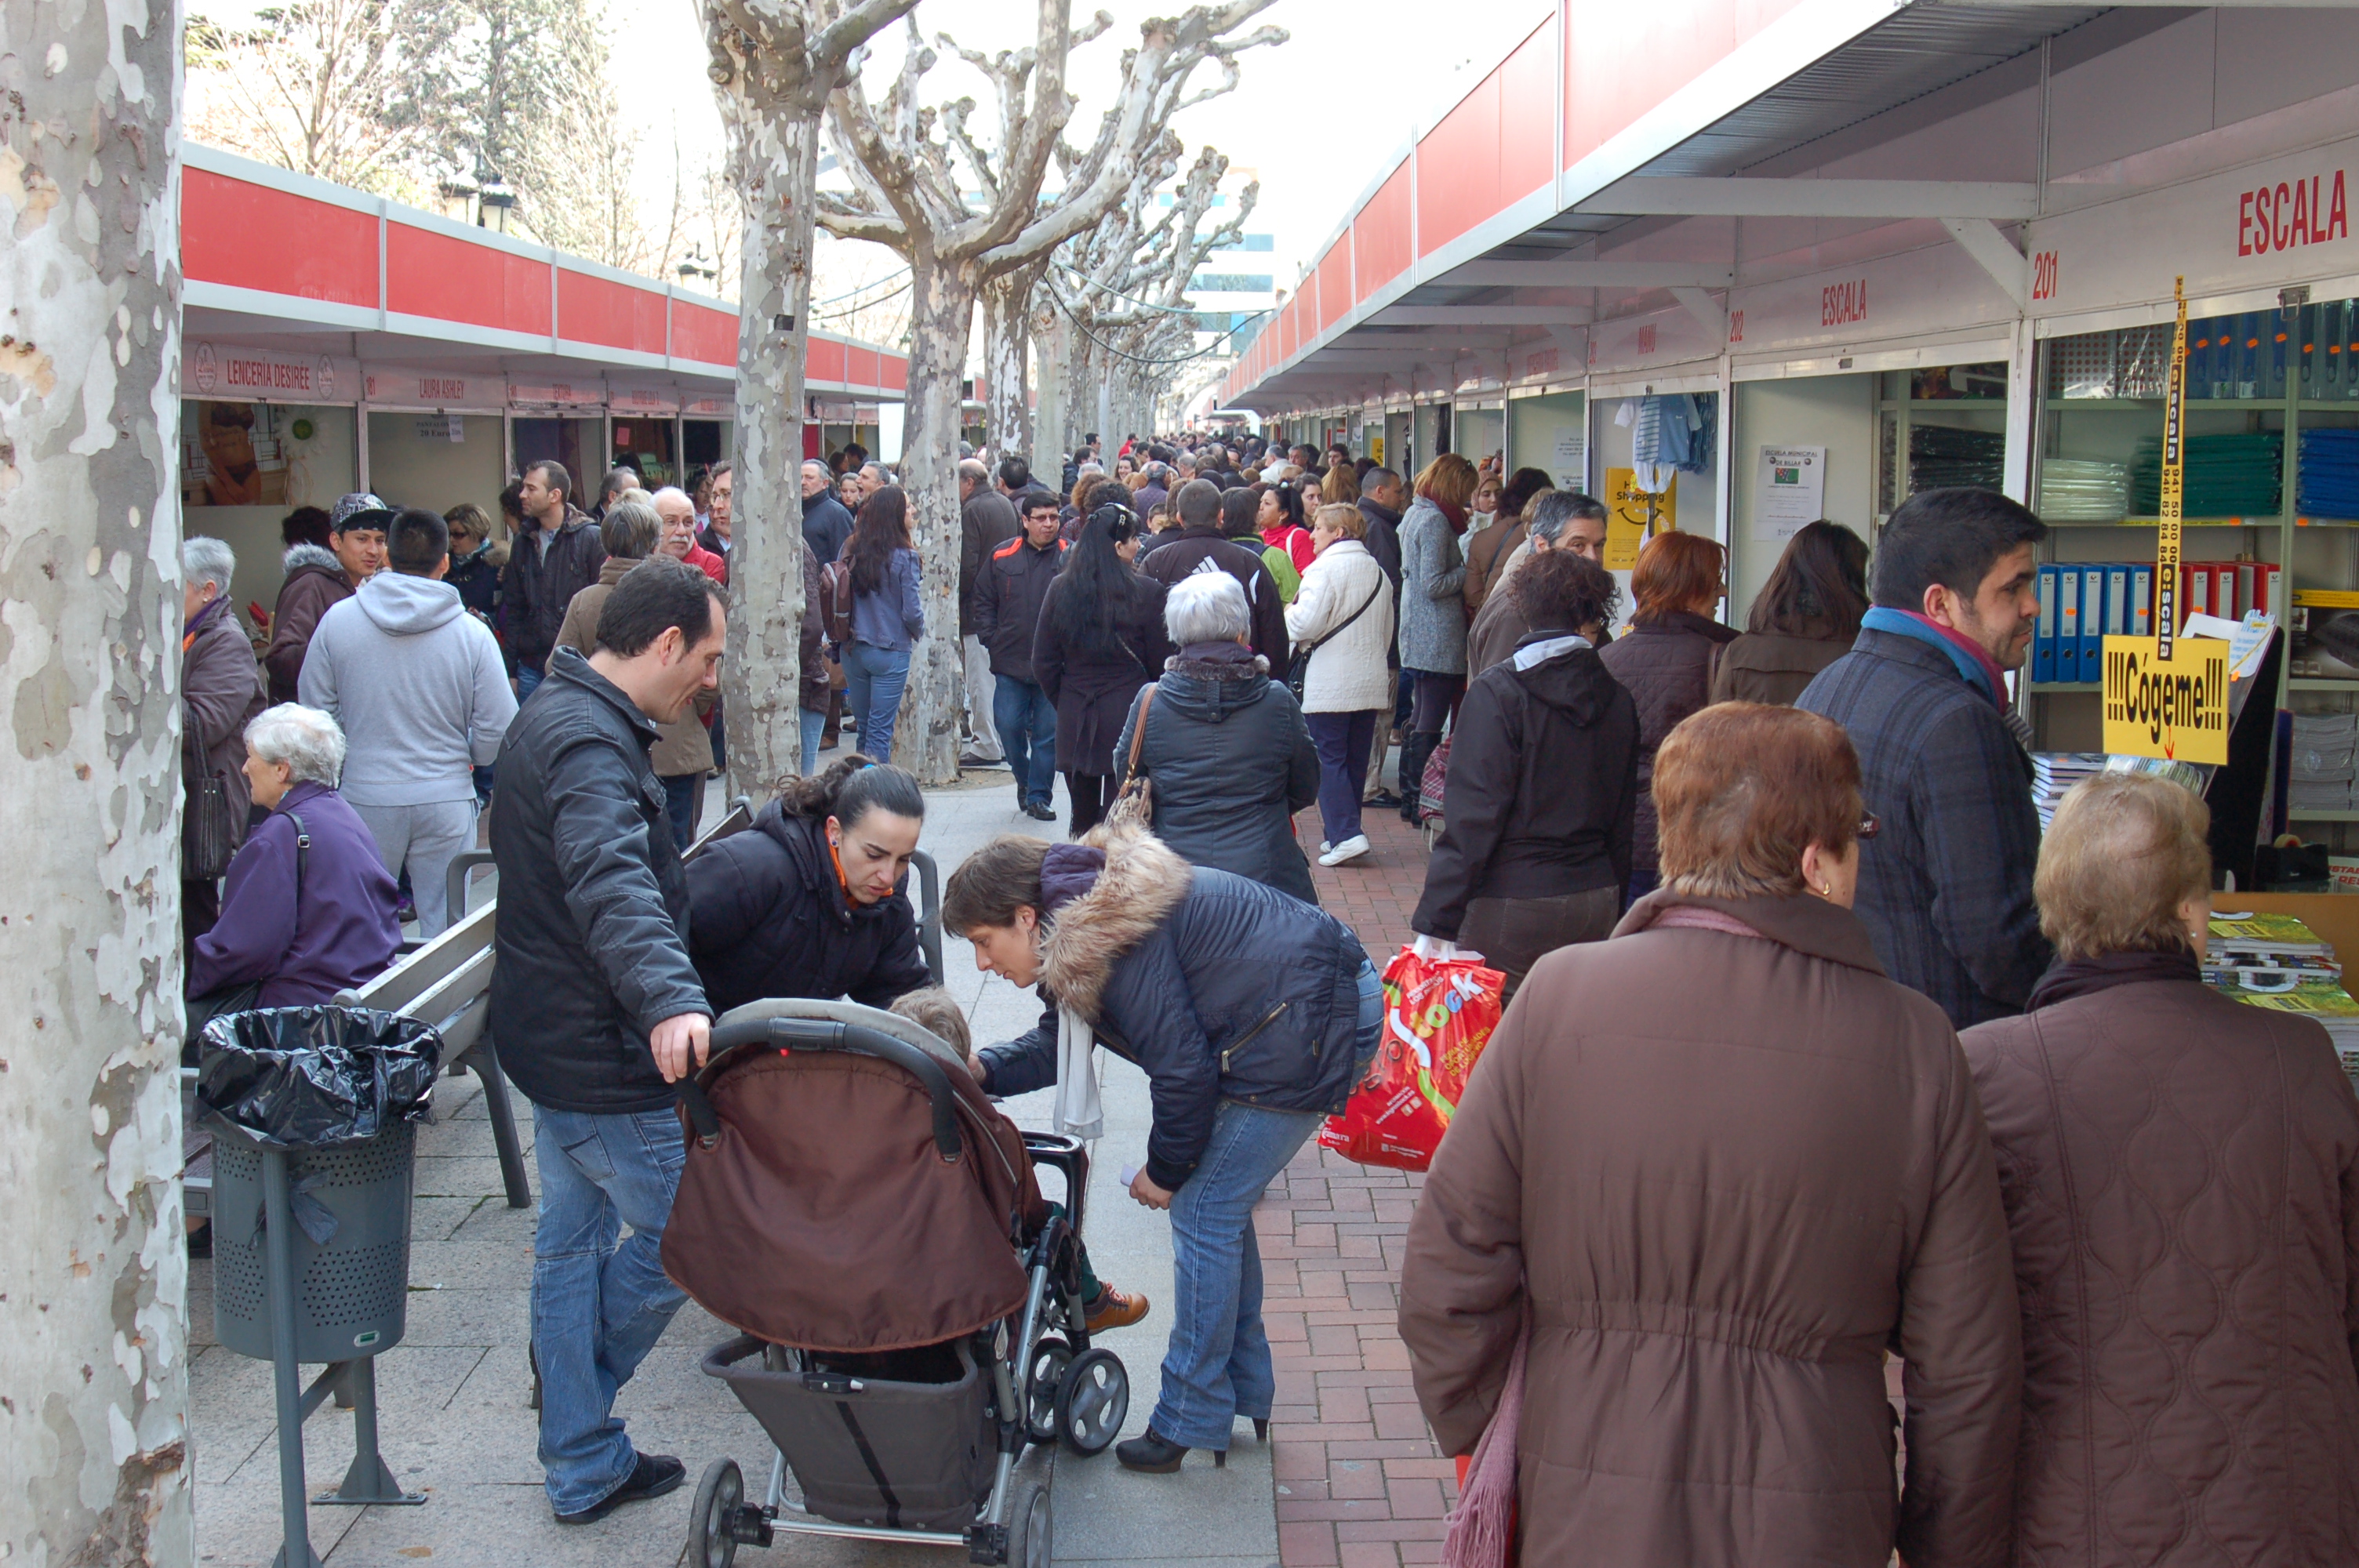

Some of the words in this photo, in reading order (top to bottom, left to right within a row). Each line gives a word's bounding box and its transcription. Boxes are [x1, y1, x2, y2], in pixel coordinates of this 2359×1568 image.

[2238, 169, 2347, 256] ESCALA
[2033, 250, 2058, 299] 201
[1822, 278, 1866, 326] ESCALA
[1730, 310, 1743, 343] 202
[227, 357, 272, 387] LENCERÍA
[274, 361, 310, 390] DESIRÉE
[420, 378, 440, 398] LAURA
[442, 379, 464, 399] ASHLEY
[1616, 491, 1665, 503] Shppg
[2161, 501, 2169, 517] 82
[2172, 501, 2179, 517] 50
[2161, 523, 2168, 540] 84
[2171, 524, 2178, 540] 00
[2160, 546, 2168, 562] 84
[2169, 546, 2177, 563] 00
[2108, 652, 2223, 745] !!!Cógeme!!!
